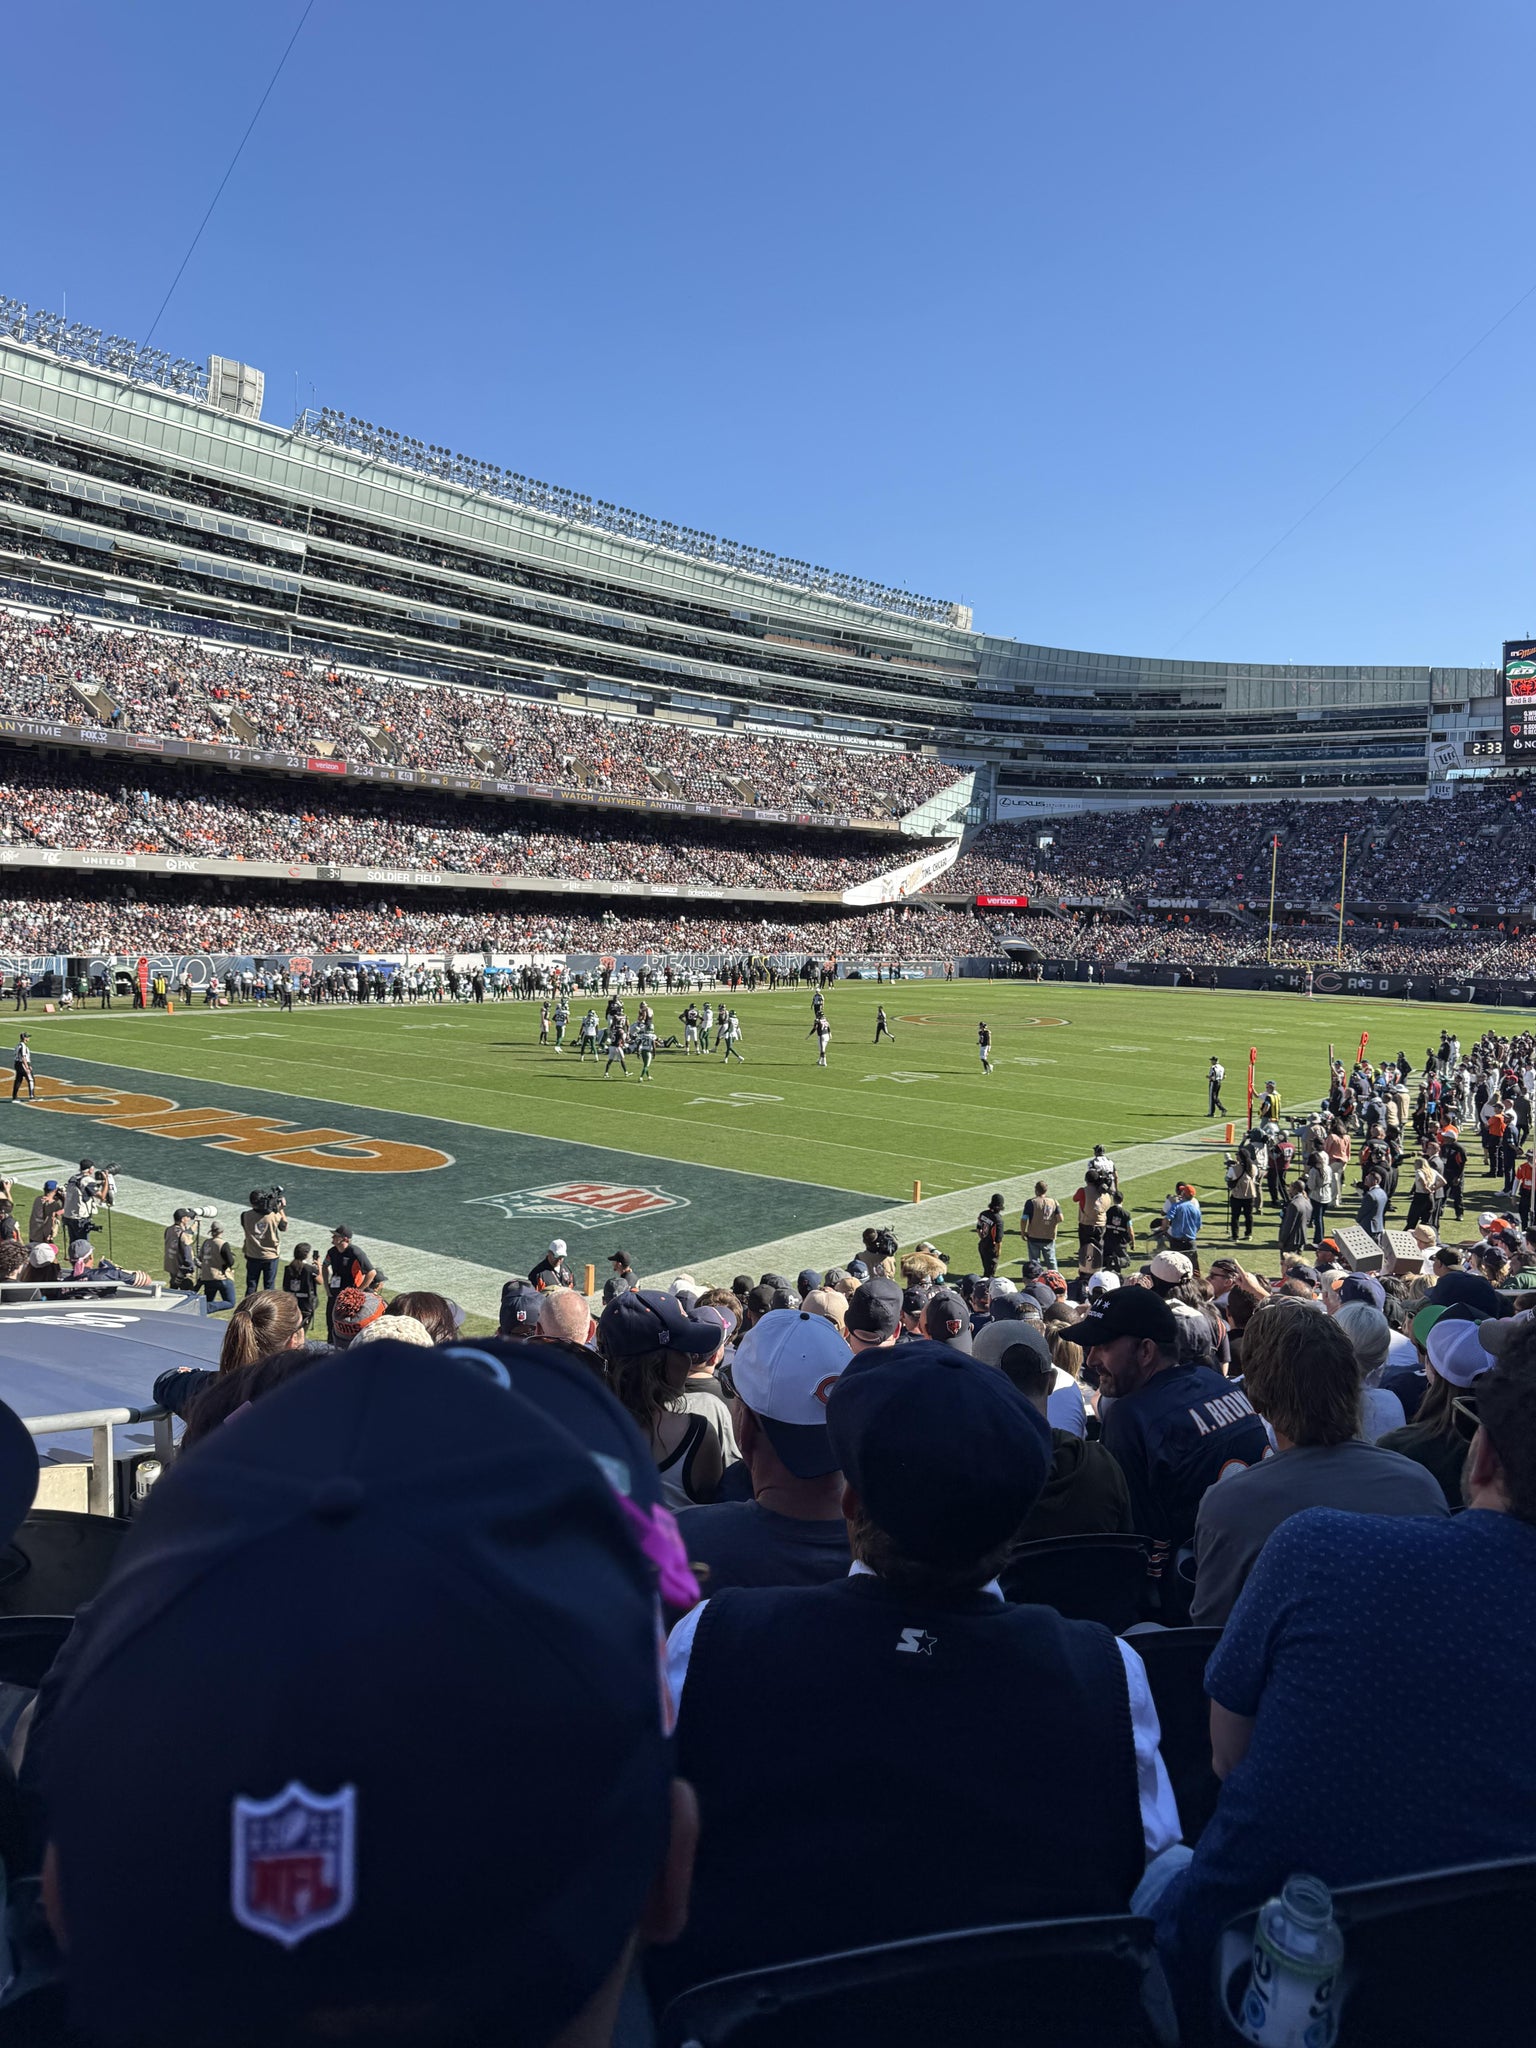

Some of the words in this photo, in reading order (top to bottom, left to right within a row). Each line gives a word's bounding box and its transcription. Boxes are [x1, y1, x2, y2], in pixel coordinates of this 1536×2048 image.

[80, 730, 97, 740] FOX
[1473, 742, 1503, 755] 2:33
[228, 750, 240, 760] 12
[287, 757, 299, 767] 23
[353, 765, 374, 776] 2:34
[389, 771, 395, 780] 4
[421, 774, 427, 784] 2
[442, 776, 449, 786] 8
[470, 780, 481, 790] 22
[560, 791, 594, 802] WATCH
[597, 795, 647, 807] ANYWHERE
[650, 801, 687, 812] ANYTIME
[82, 856, 125, 866] UNITED
[177, 859, 200, 871] PNC
[367, 871, 410, 883] SOLDIER
[414, 874, 442, 885] FIELD
[986, 896, 1018, 906] verizon
[1059, 896, 1105, 906] BEAR
[1147, 898, 1199, 909] DOWN
[547, 1184, 675, 1215] NFL
